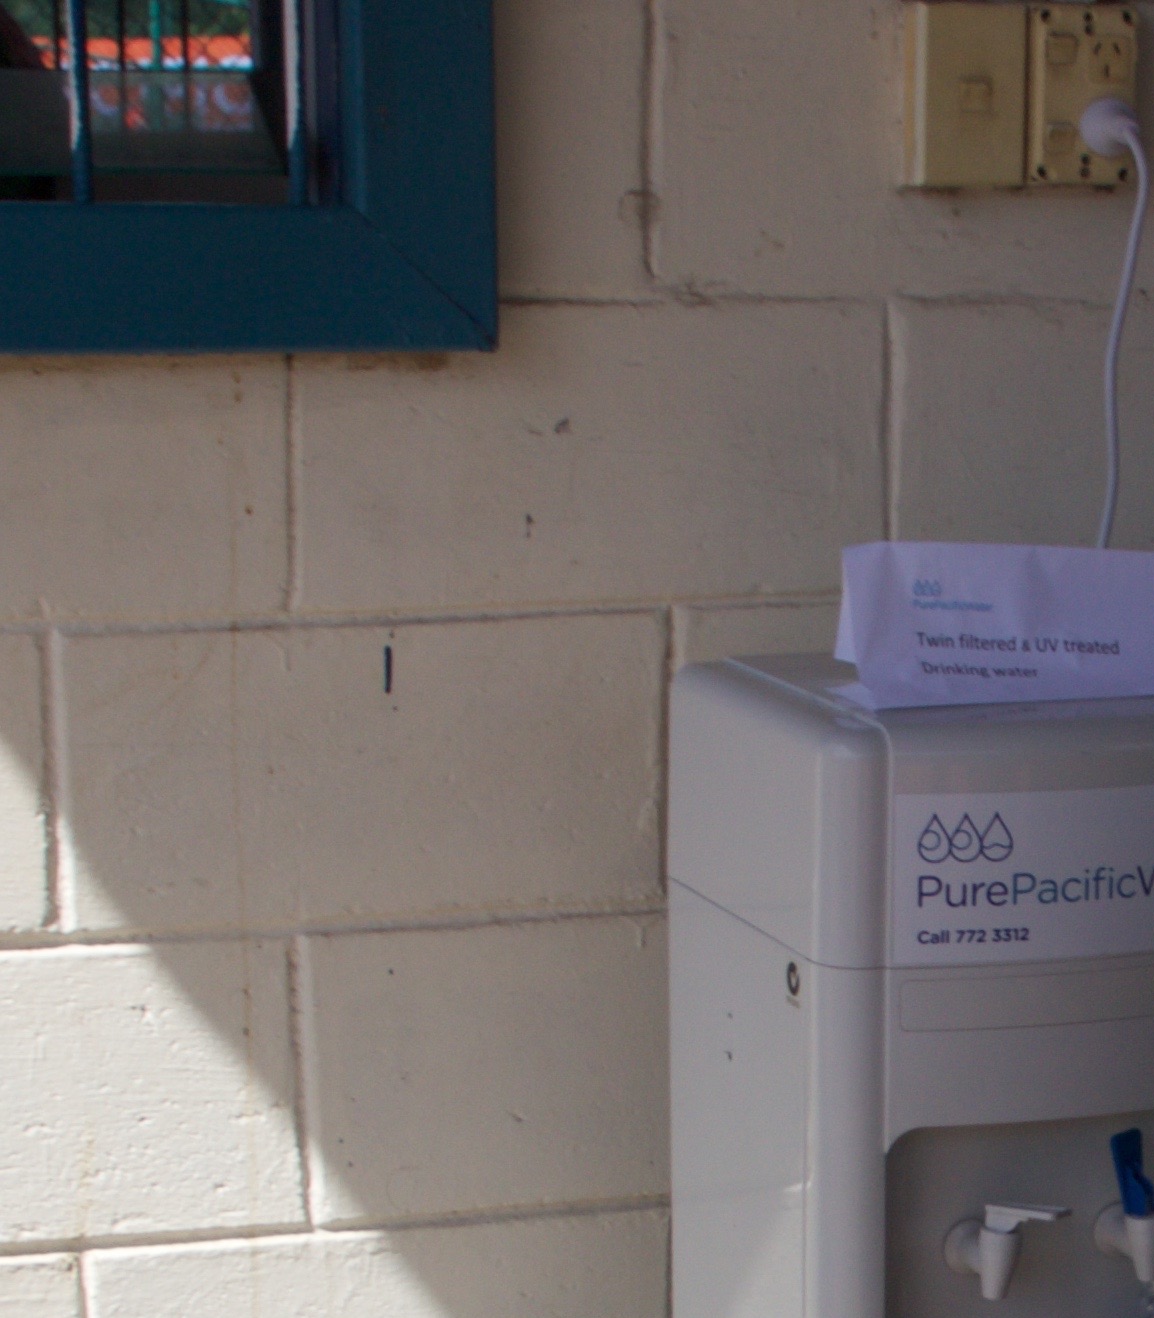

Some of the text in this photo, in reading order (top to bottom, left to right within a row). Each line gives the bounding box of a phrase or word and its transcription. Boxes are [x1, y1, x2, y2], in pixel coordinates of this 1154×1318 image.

[916, 632, 955, 649] Twin
[958, 634, 1016, 652] filtered
[1035, 637, 1059, 653] UV
[1063, 640, 1120, 656] treated
[921, 660, 1038, 679] Drinking water
[917, 927, 1030, 945] Call 772 3312
